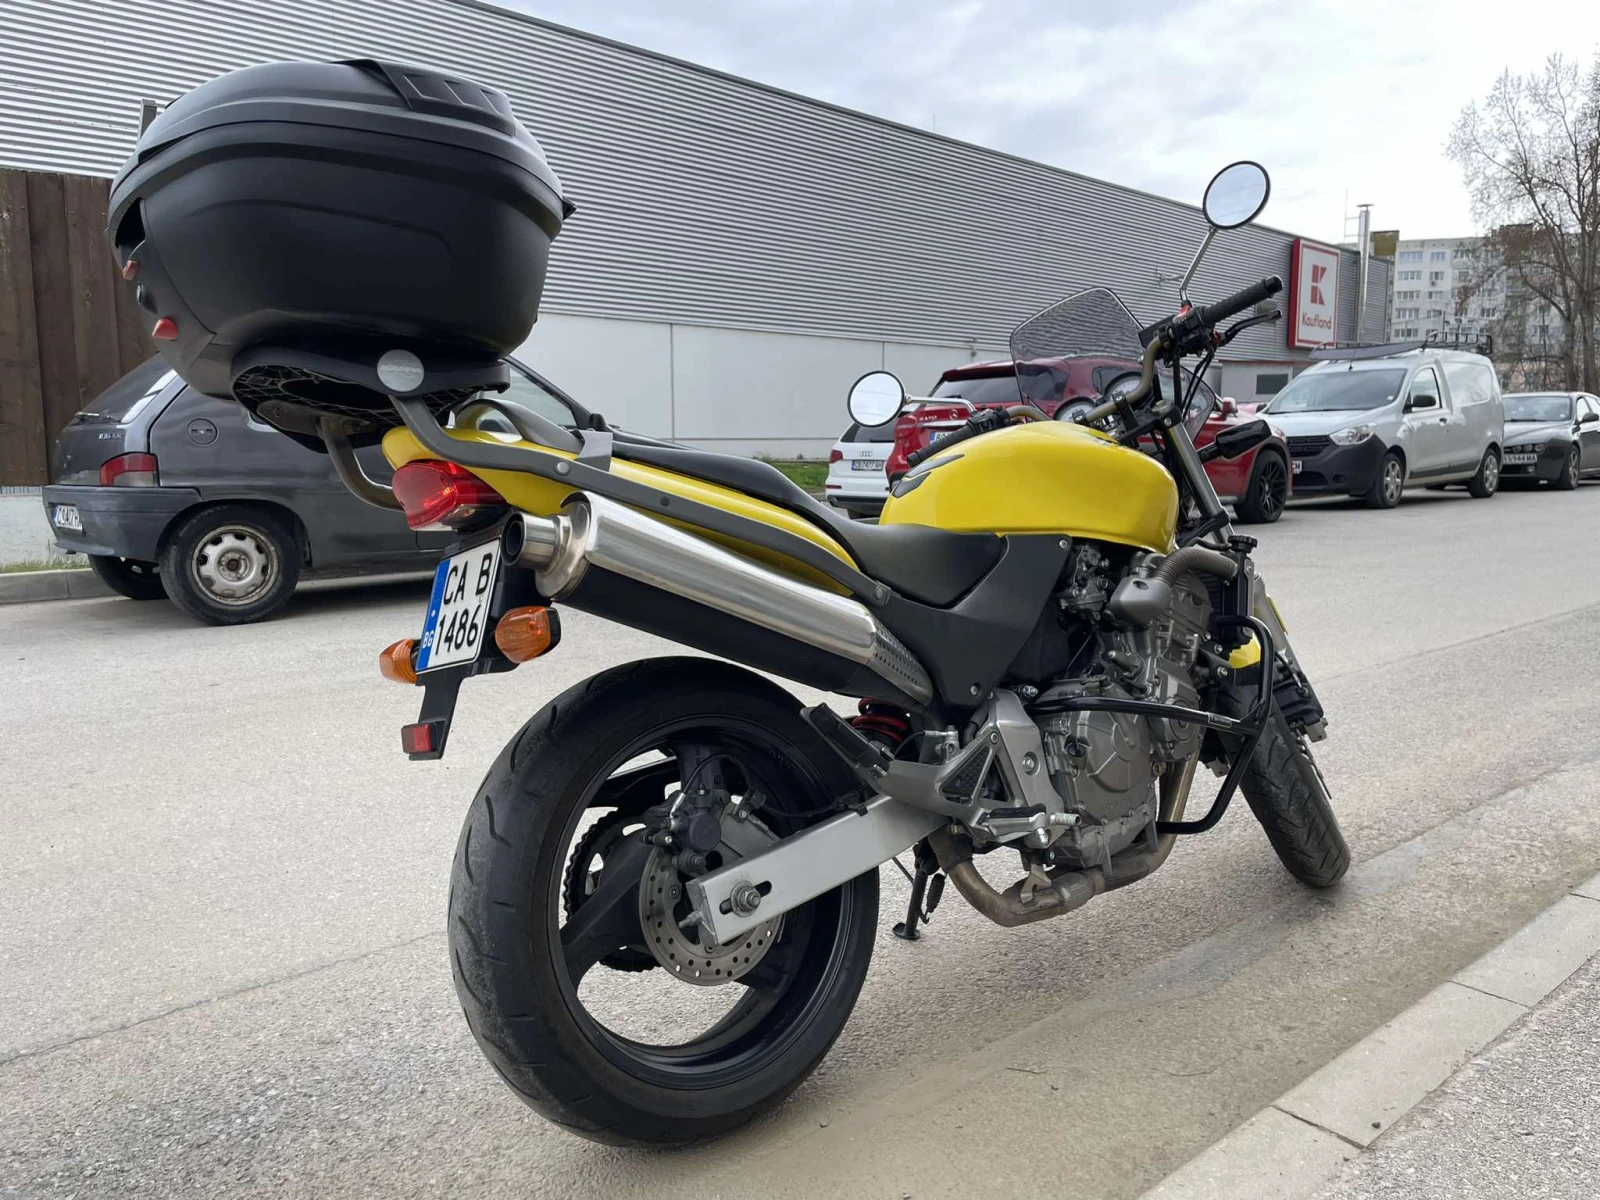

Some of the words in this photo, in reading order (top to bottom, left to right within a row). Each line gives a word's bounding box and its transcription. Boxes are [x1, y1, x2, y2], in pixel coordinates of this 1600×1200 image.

[1310, 264, 1327, 306] K
[1302, 312, 1332, 330] Kaufland
[444, 561, 468, 605] CA
[475, 552, 493, 596] B
[422, 630, 434, 649] BG
[435, 604, 482, 655] 1486
